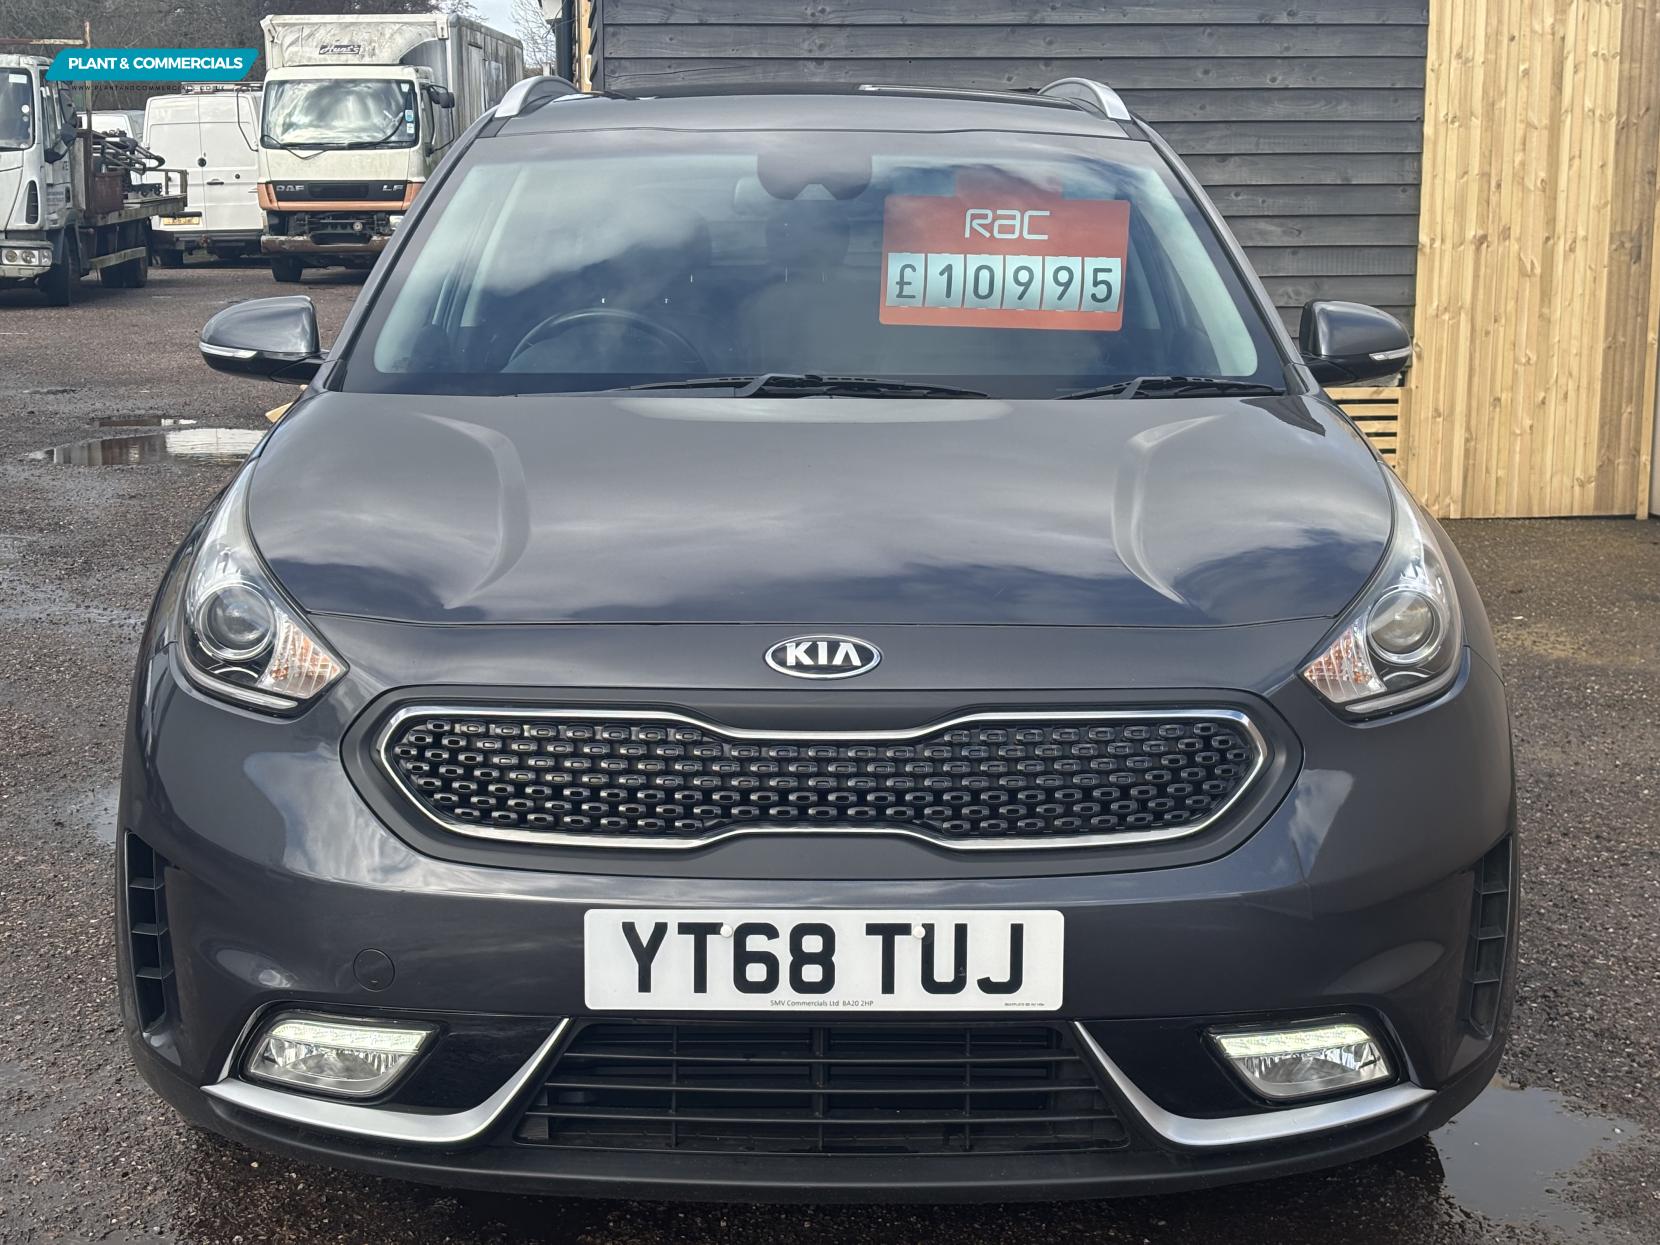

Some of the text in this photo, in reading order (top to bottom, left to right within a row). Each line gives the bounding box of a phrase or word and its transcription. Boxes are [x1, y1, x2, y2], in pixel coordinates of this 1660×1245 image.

[785, 641, 862, 666] KIA
[621, 921, 1024, 994] YT68 TUJ
